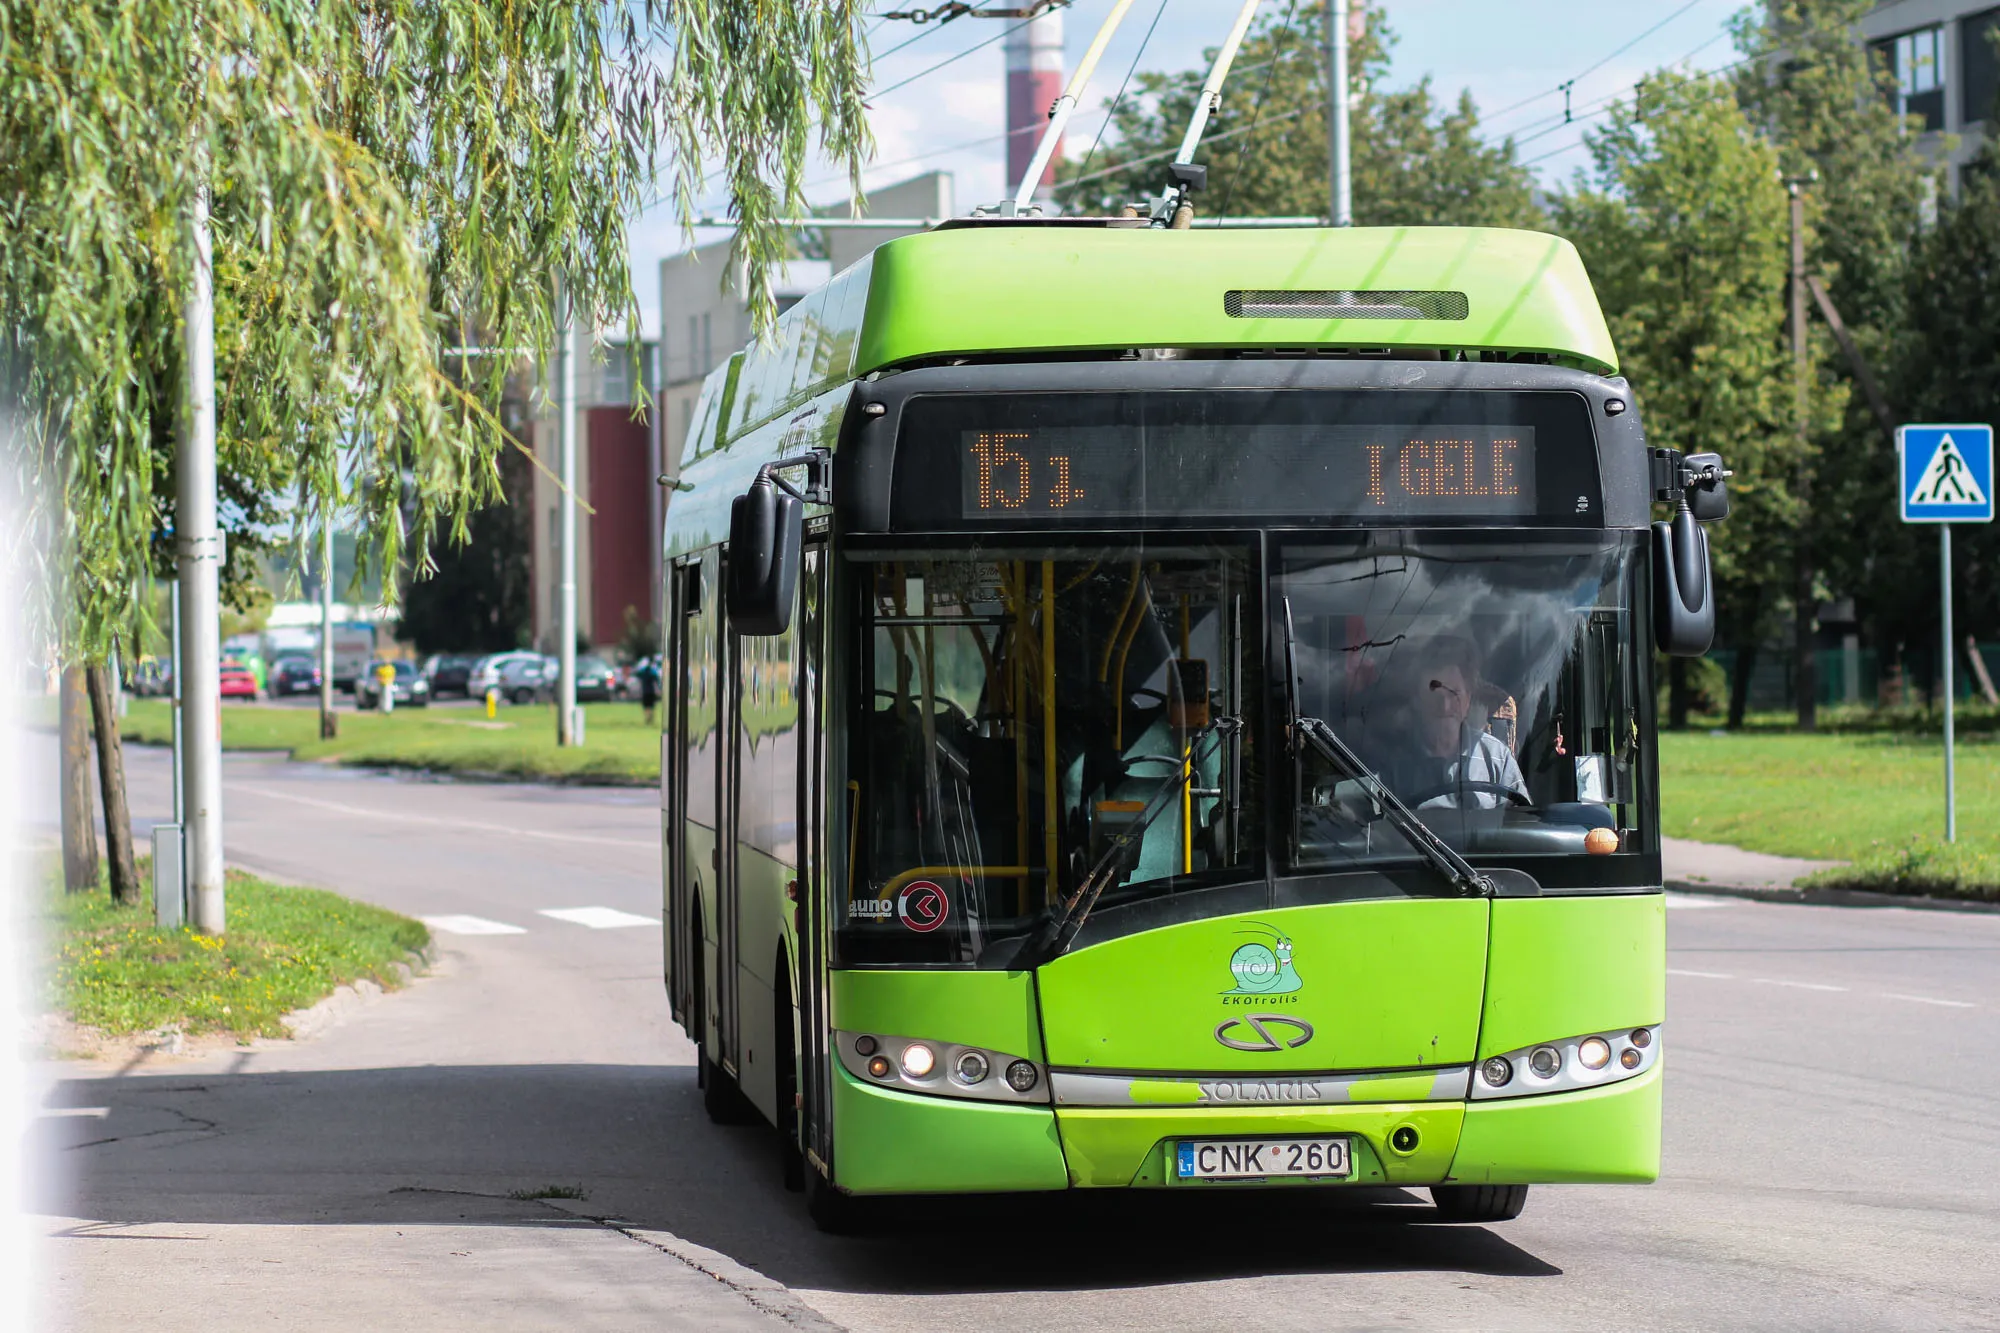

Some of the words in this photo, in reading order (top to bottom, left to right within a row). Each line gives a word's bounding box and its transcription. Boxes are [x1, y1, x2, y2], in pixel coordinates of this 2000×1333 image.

[970, 433, 1029, 508] 15
[1400, 439, 1519, 496] GELE
[1222, 994, 1298, 1005] EKOtrolis
[1197, 1079, 1322, 1102] SOLARIS
[1179, 1162, 1193, 1173] LT
[1198, 1143, 1264, 1173] CNK
[1287, 1142, 1343, 1172] 260
